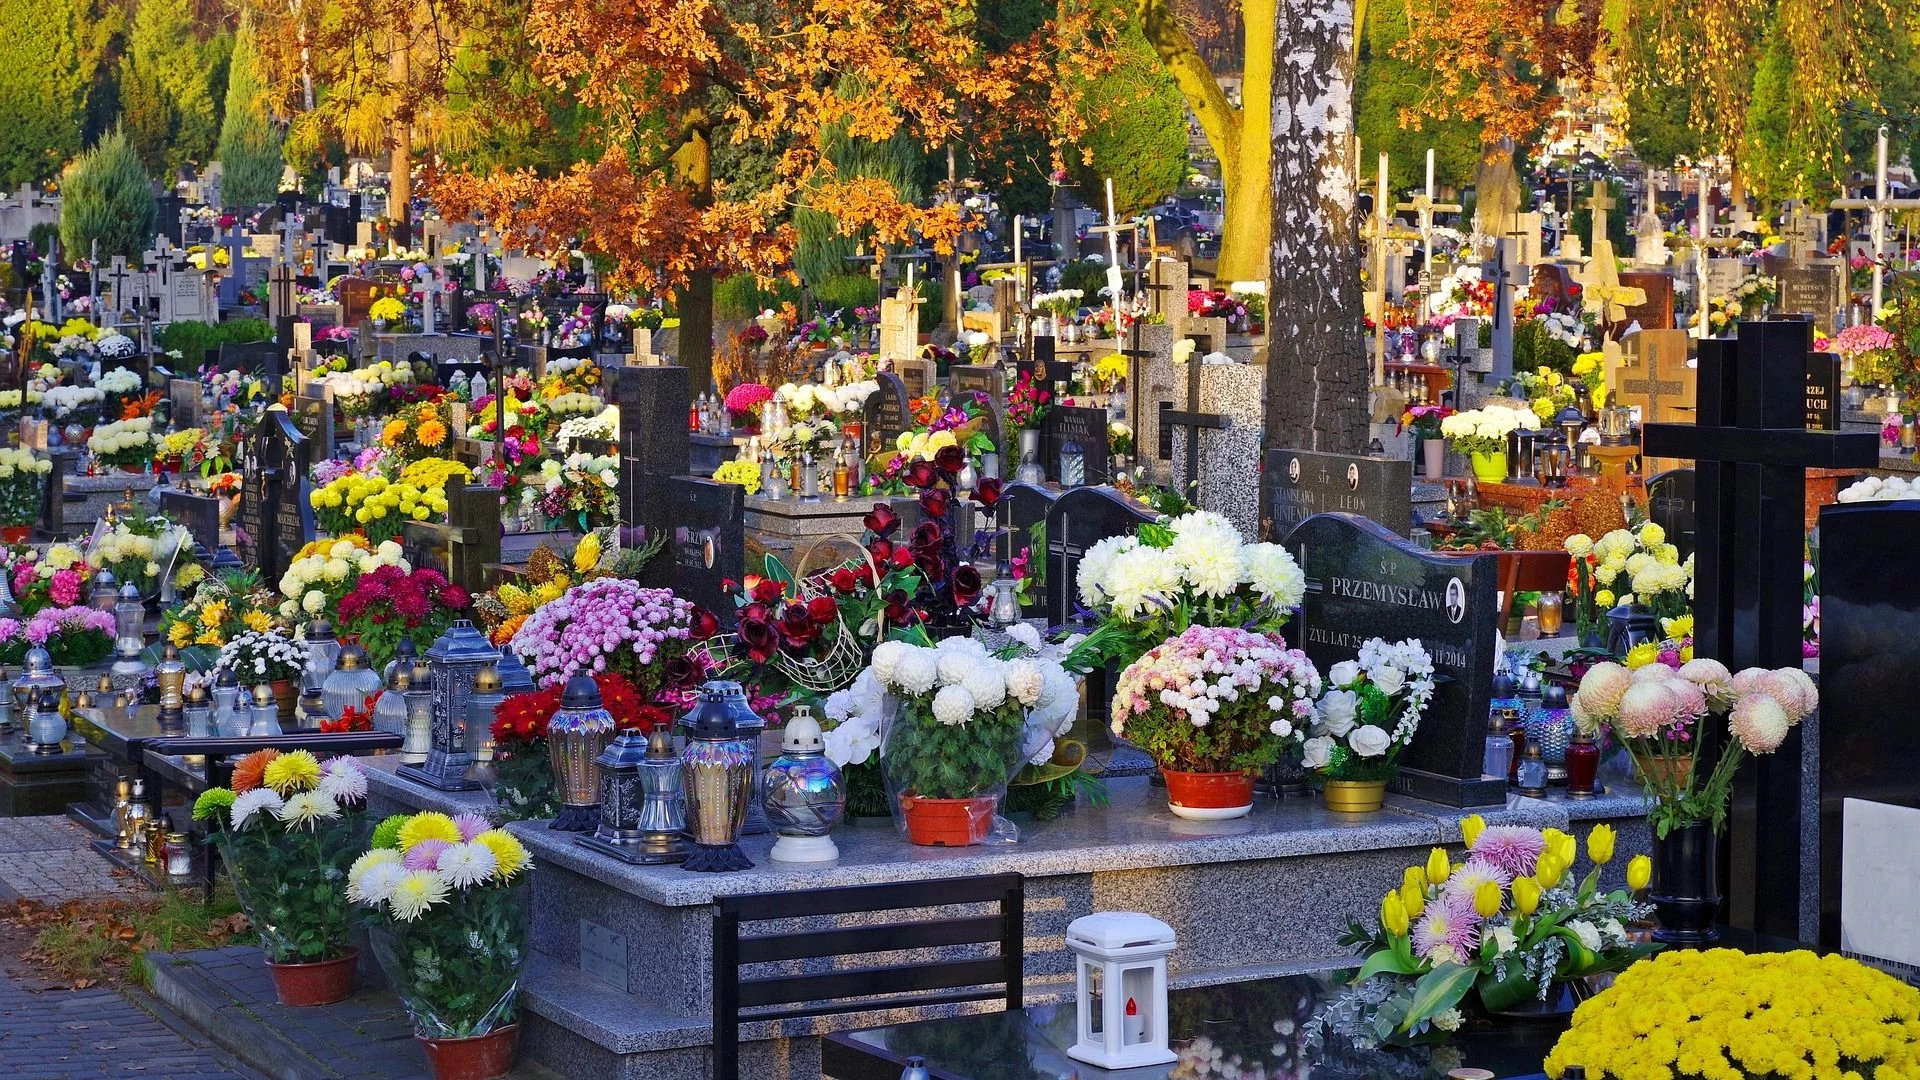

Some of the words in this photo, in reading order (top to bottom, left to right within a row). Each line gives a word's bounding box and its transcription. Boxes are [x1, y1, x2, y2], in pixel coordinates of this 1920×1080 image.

[684, 530, 703, 546] JERZY
[1331, 576, 1444, 611] PRZEMYSŁAW
[1330, 631, 1350, 647] LAT
[1445, 651, 1467, 669] 2014
